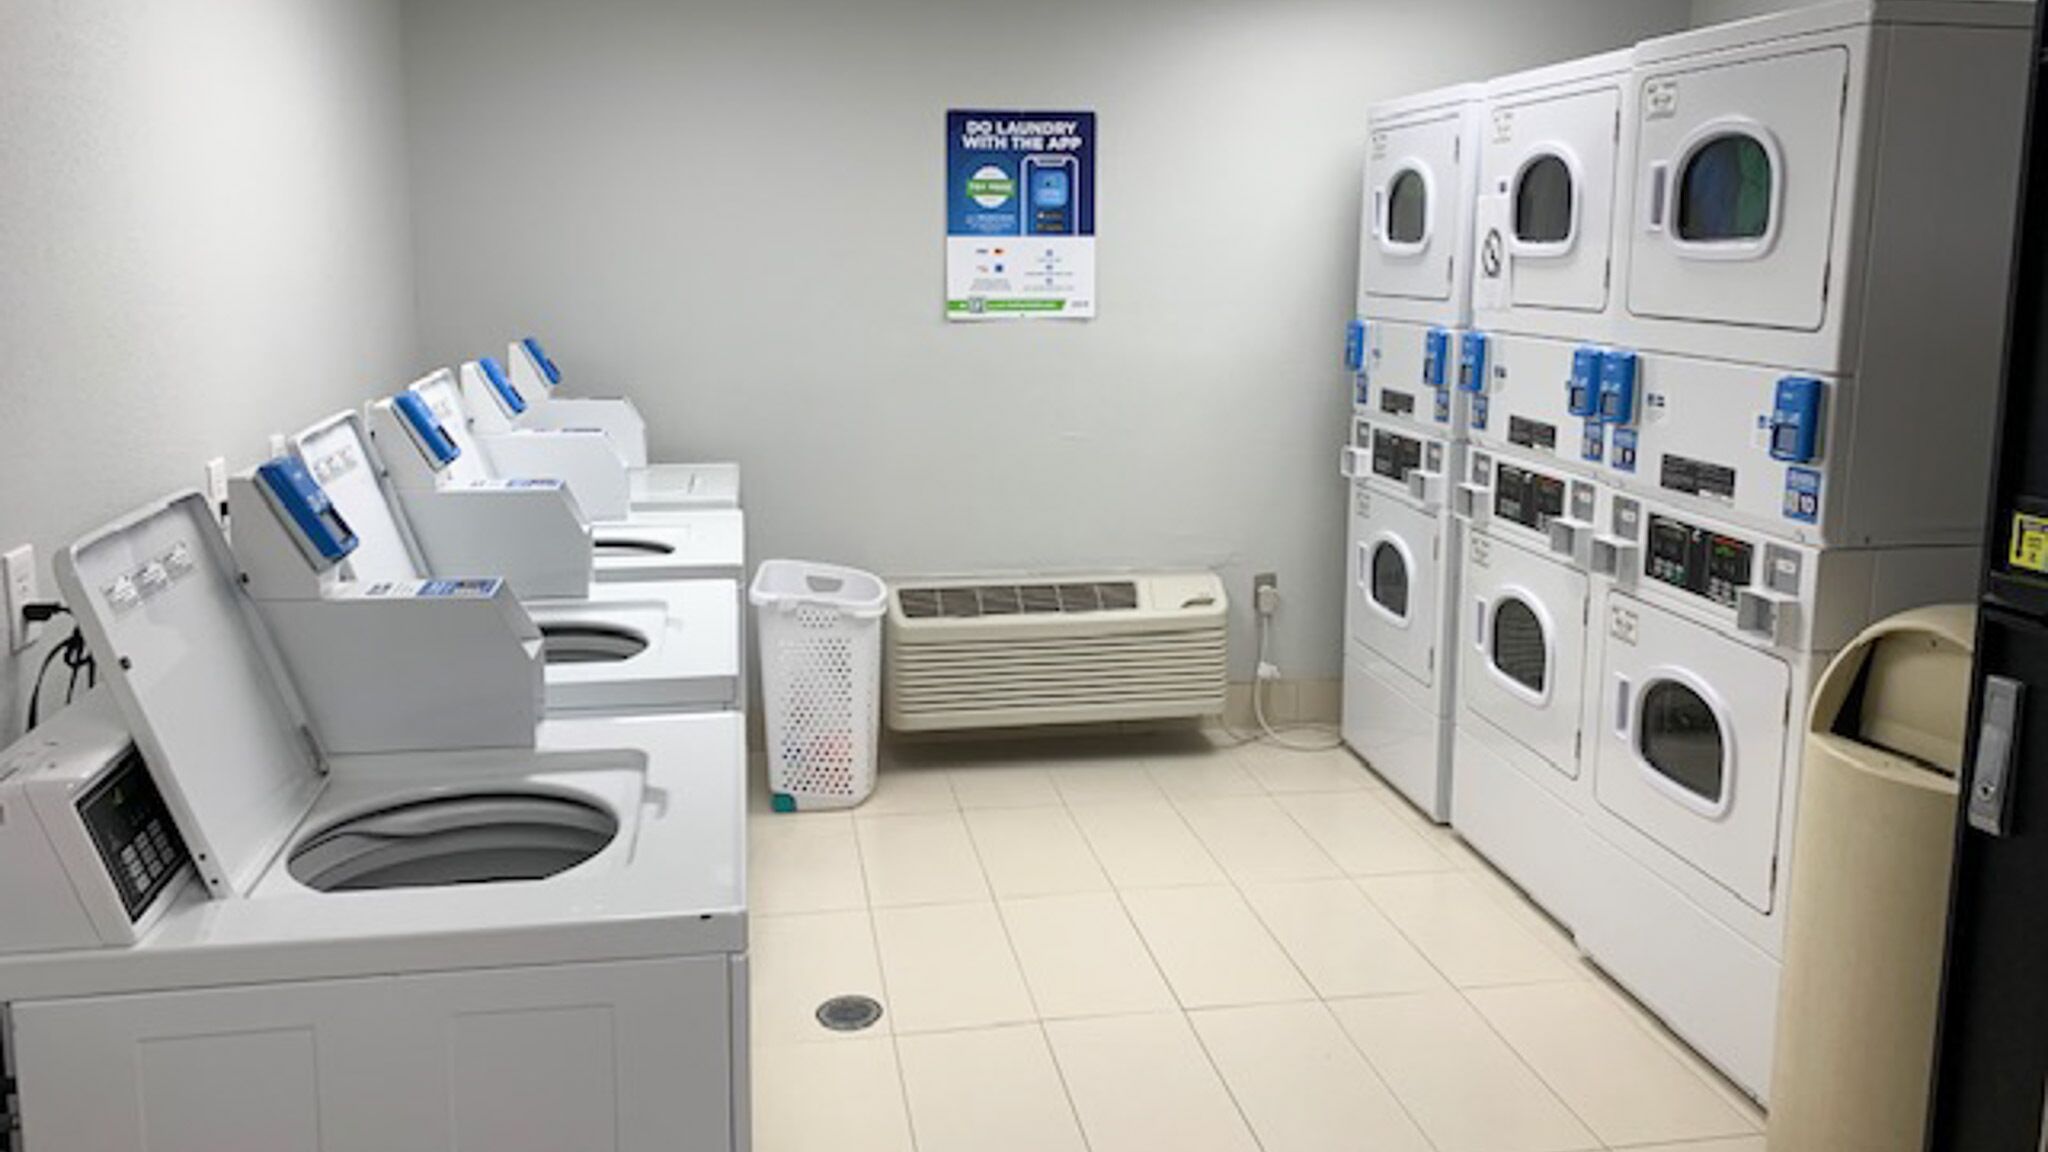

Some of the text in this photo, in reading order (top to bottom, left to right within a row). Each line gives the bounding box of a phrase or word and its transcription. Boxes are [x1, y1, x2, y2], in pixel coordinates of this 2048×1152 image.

[966, 121, 1077, 135] DO LAUNDRY
[962, 135, 1083, 151] WITH THE APP
